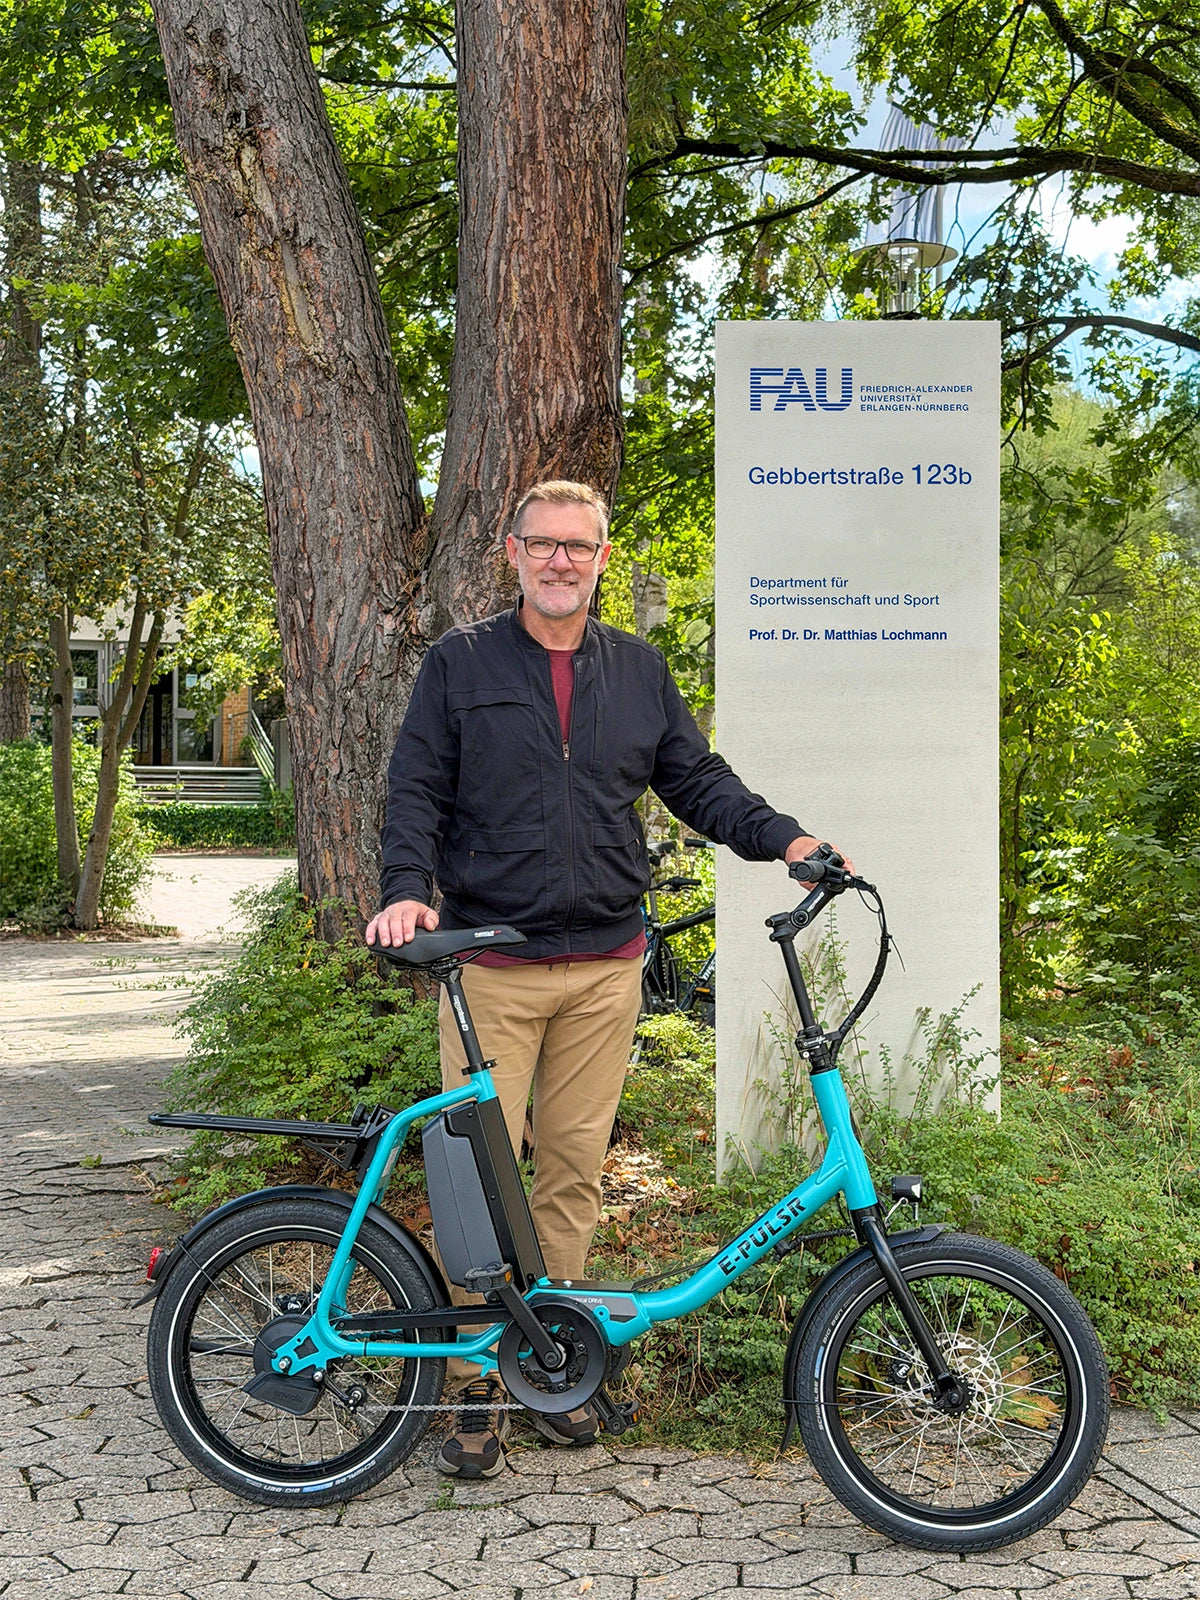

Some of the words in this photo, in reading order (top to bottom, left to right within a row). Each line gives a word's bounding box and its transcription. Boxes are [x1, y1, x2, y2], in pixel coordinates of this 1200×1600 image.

[750, 367, 853, 411] FAU
[860, 385, 973, 393] FRIEDRICH-ALEXANDER
[860, 393, 922, 402] UNIVERSITÄT
[860, 402, 969, 412] ERLANGEN-NÜRNBERG
[748, 466, 904, 485] Gebbertstraße
[911, 463, 973, 485] 123b
[750, 576, 827, 591] Department
[830, 576, 849, 588] für
[749, 594, 871, 607] Sportwissenschaft
[874, 594, 900, 606] und
[903, 594, 940, 608] Sport
[749, 629, 778, 641] Prof.
[782, 629, 799, 641] Dr.
[803, 629, 821, 641] Dr.
[824, 629, 878, 641] Matthias
[881, 629, 948, 641] Lochmann
[717, 1196, 808, 1277] E-PULSR
